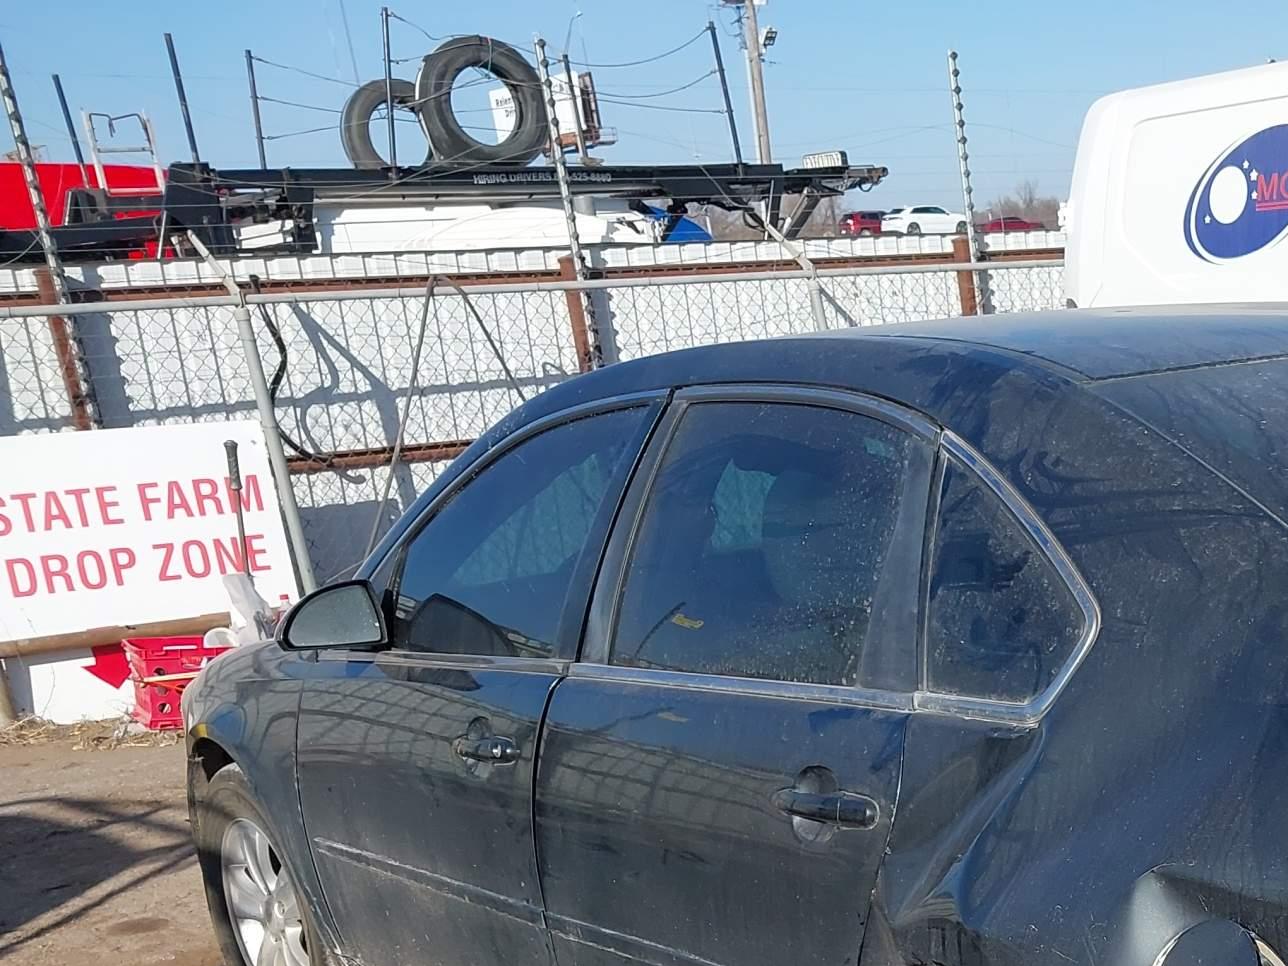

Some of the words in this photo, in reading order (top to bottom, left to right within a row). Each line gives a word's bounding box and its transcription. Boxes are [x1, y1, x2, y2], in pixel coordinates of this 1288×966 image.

[473, 173, 507, 184] HIRING
[508, 171, 552, 183] DRIVERS
[136, 474, 265, 521] FARM
[4, 546, 137, 598] DROP
[151, 534, 272, 583] ZONE
